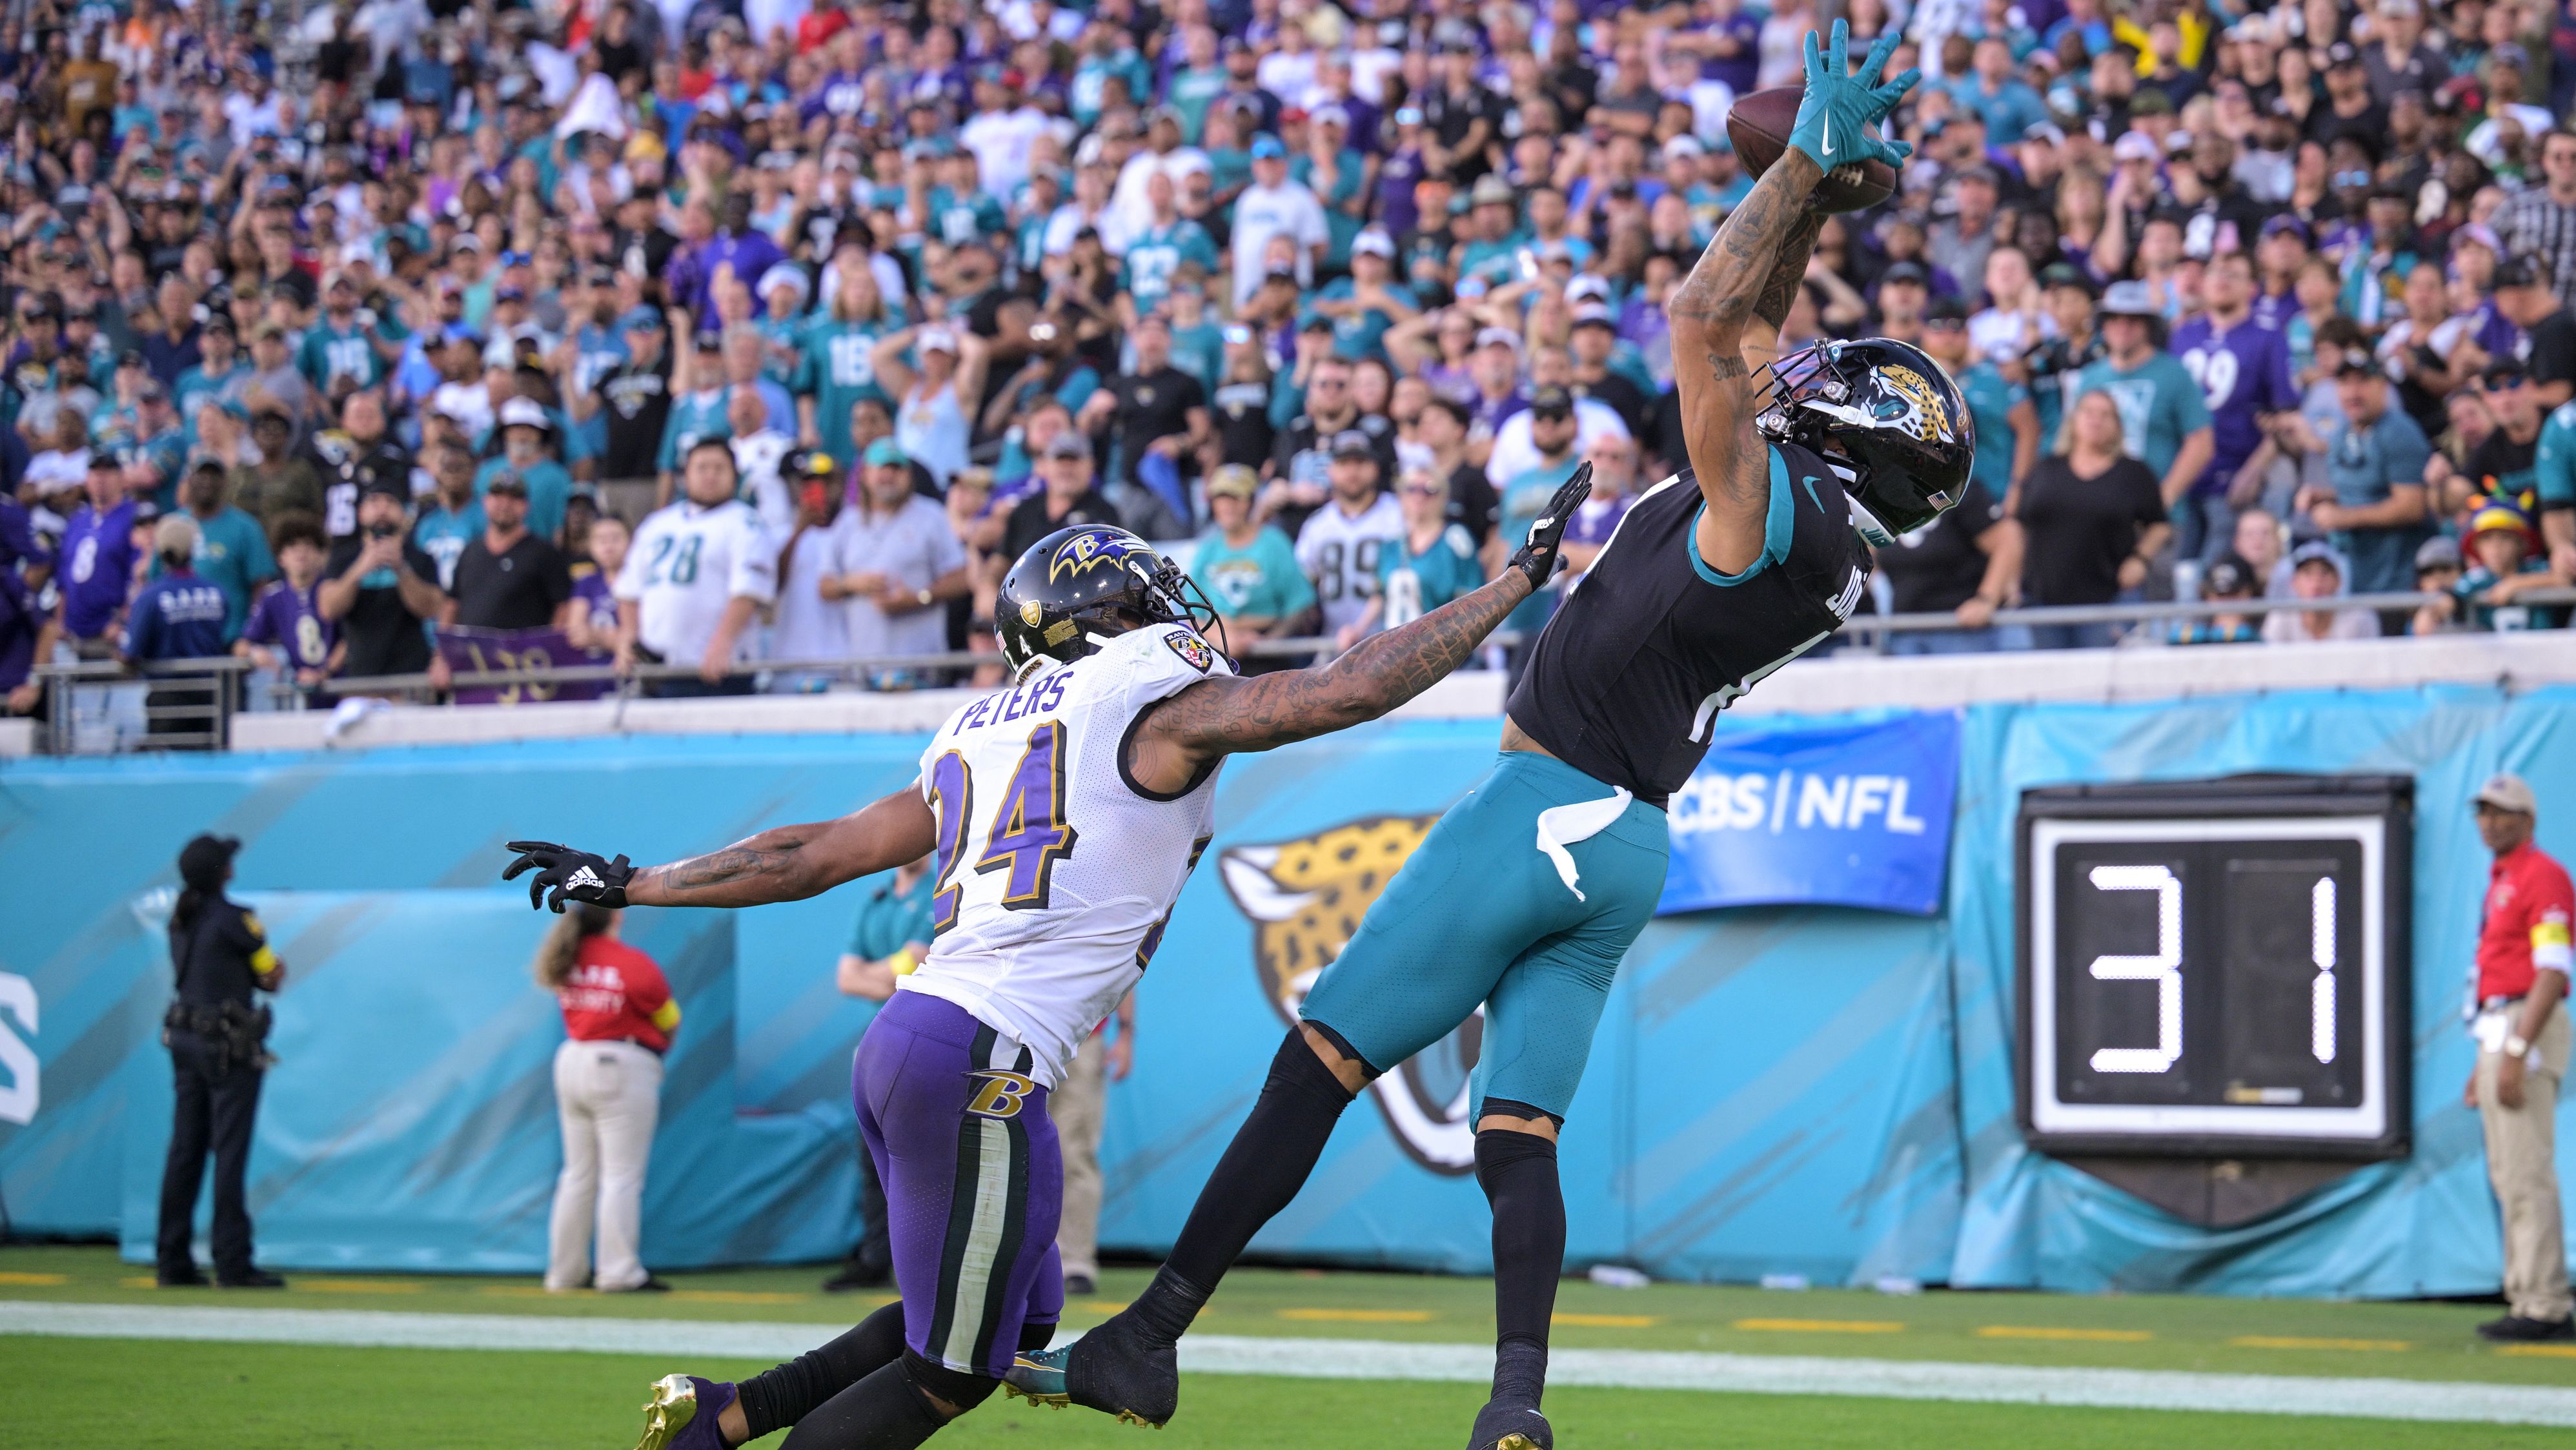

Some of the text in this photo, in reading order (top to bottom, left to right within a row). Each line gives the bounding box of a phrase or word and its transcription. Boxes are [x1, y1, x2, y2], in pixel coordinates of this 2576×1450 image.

[645, 534, 704, 586] 28
[296, 614, 325, 666] 8
[953, 671, 1074, 736] PETERS
[928, 719, 1079, 935] 24
[1665, 773, 1926, 835] CBS NFL
[566, 877, 605, 890] adidas
[2089, 866, 2336, 1072] 31
[966, 1070, 1035, 1118] B
